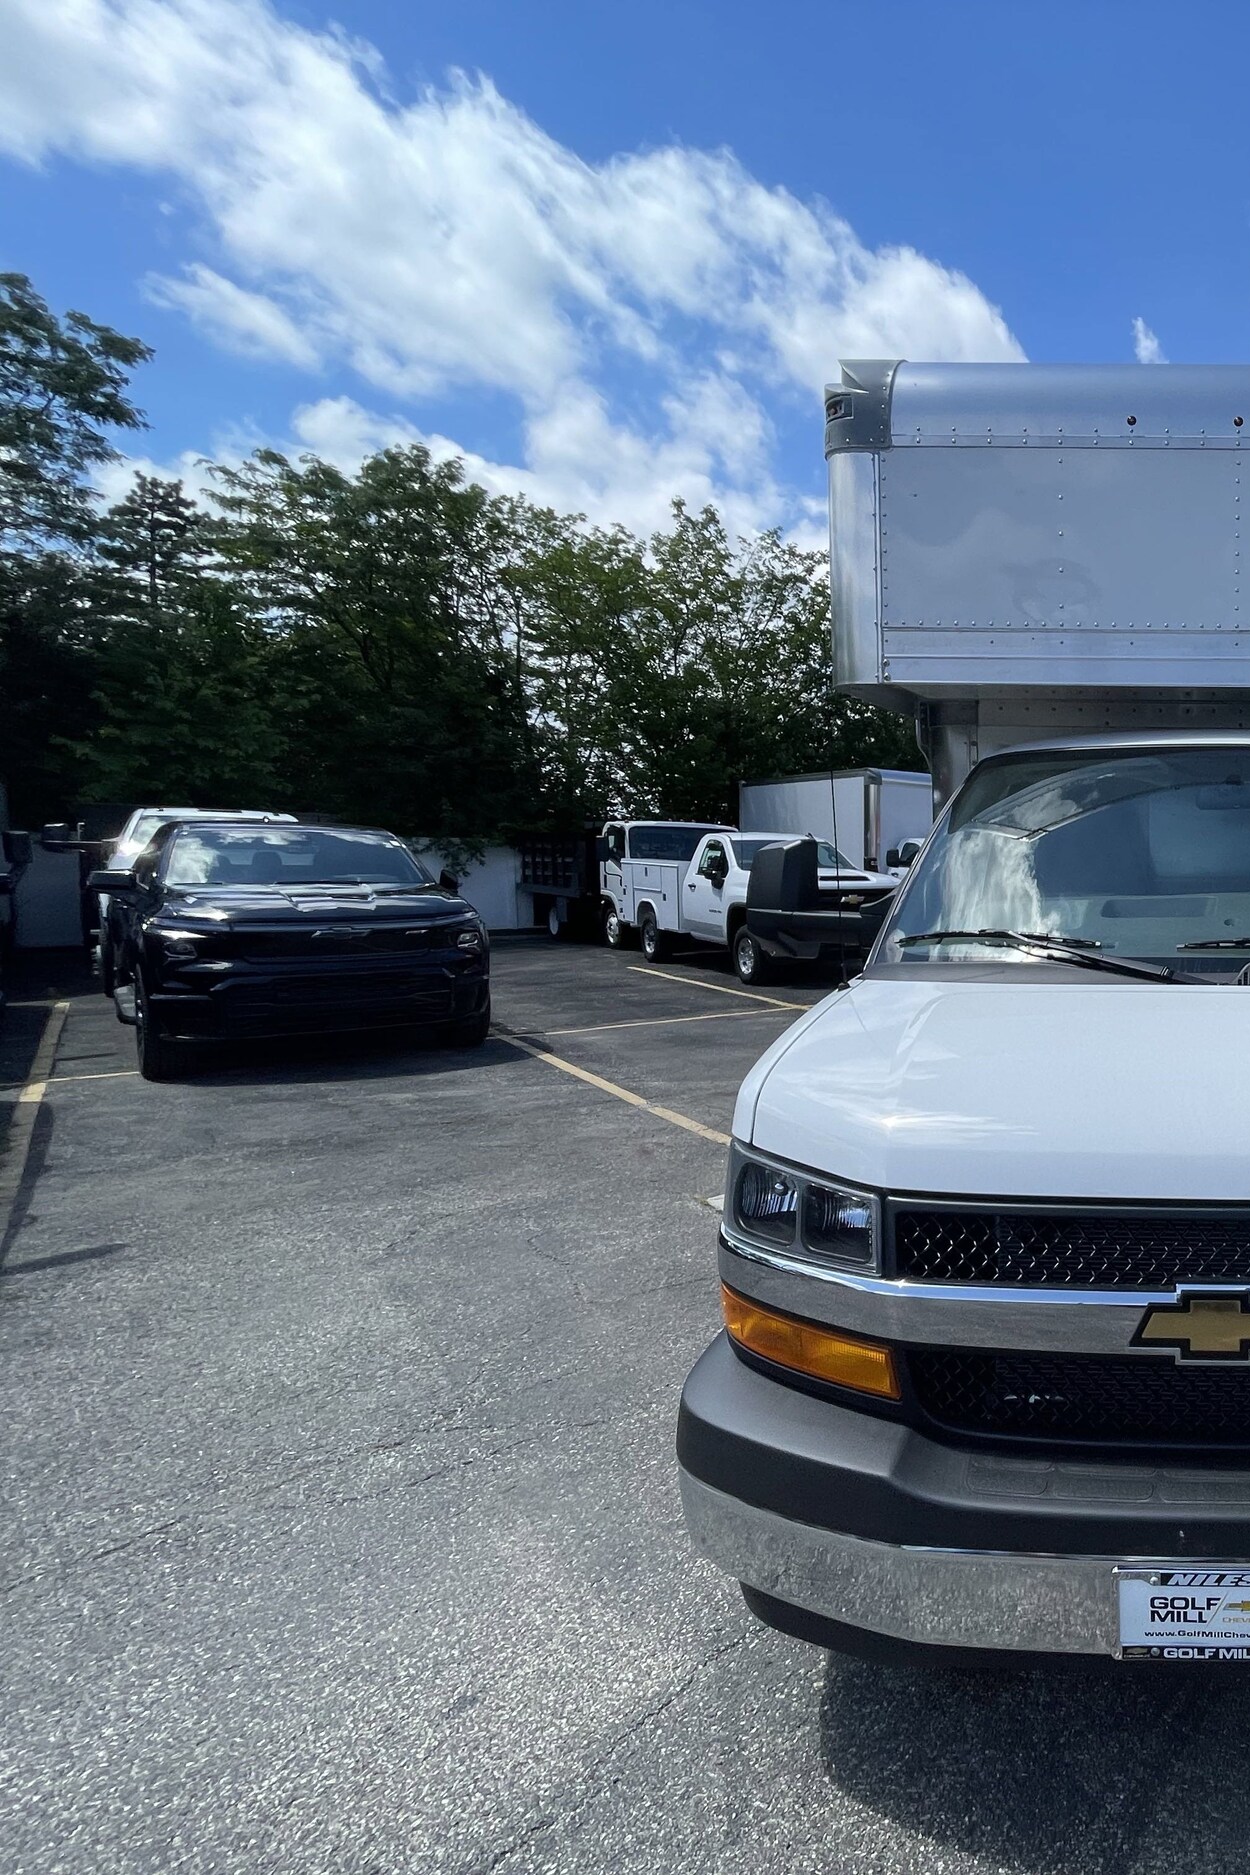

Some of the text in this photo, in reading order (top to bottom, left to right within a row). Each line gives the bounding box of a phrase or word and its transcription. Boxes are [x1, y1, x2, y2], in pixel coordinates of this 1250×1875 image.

[1150, 1597, 1221, 1610] GOLF
[1150, 1611, 1207, 1623] MILL
[1164, 1648, 1216, 1659] GOLF
